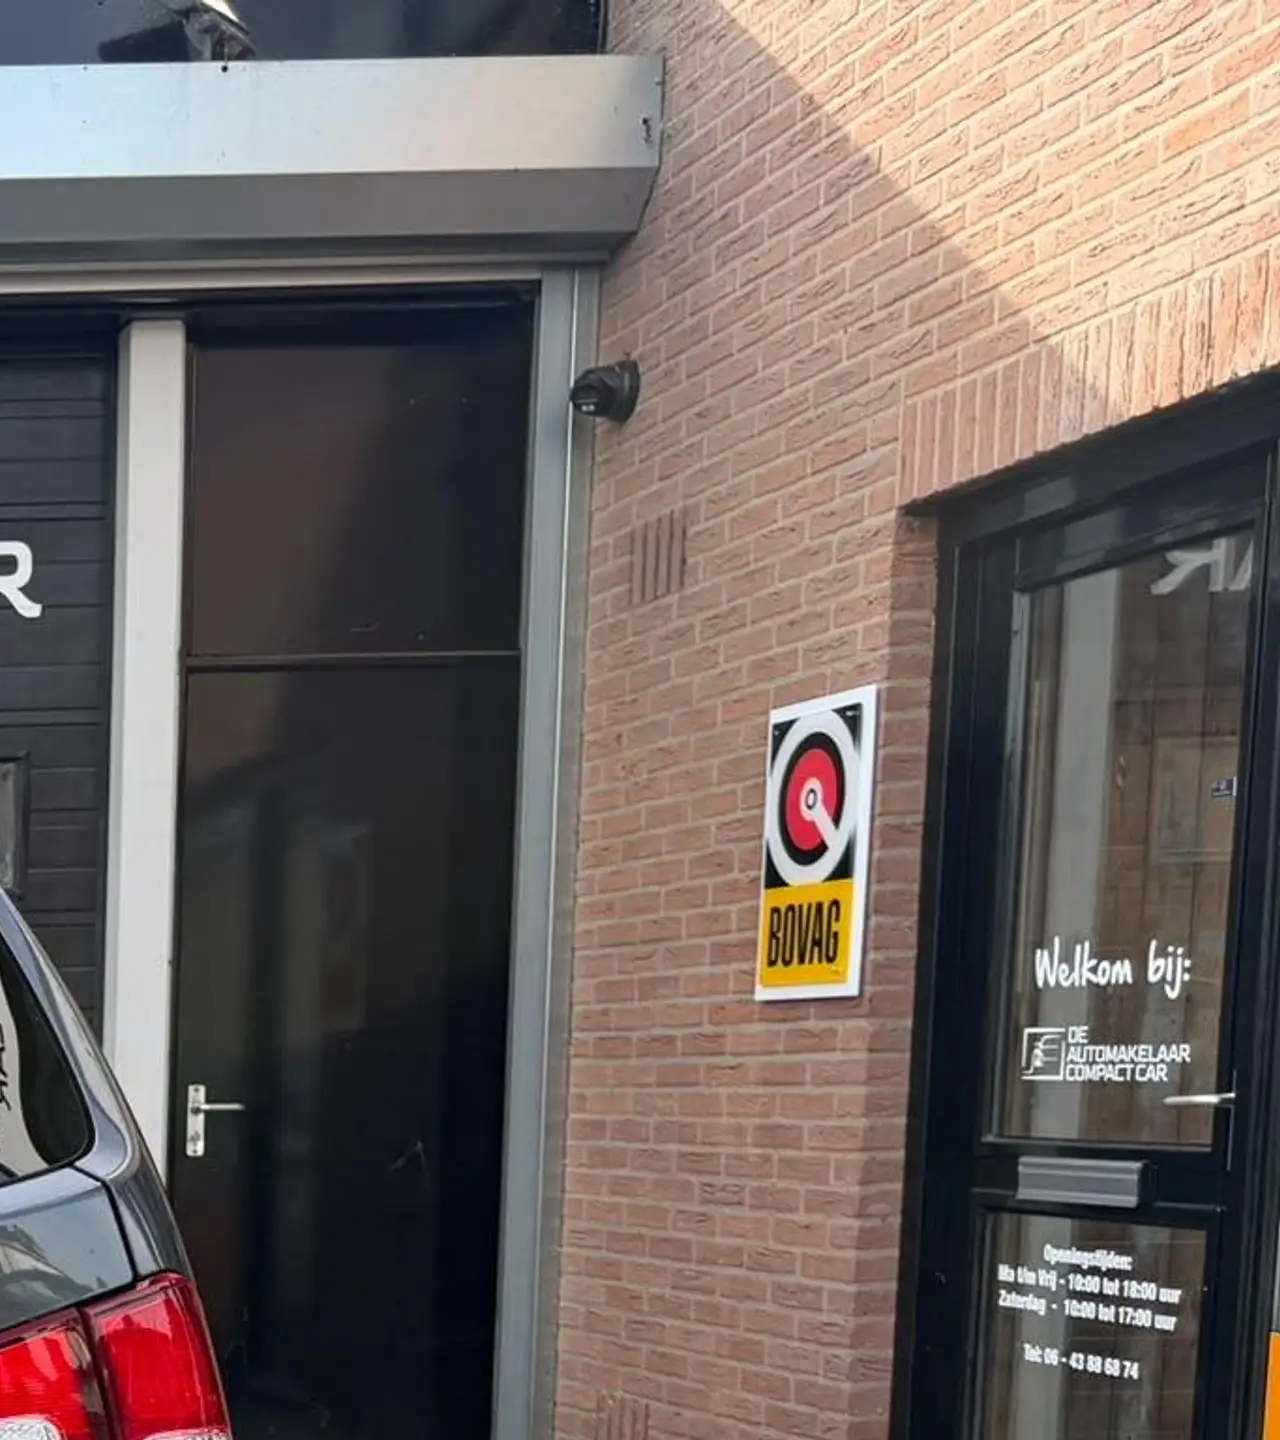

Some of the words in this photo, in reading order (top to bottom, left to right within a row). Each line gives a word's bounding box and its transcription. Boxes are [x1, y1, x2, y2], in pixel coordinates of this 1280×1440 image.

[767, 898, 842, 967] BOVAG
[1035, 935, 1133, 989] Welkom
[1147, 939, 1191, 1000] bij:
[1067, 1025, 1089, 1044] DE
[1066, 1043, 1191, 1064] AUTOMAKELAAR
[1065, 1063, 1135, 1082] COMPACT
[1135, 1064, 1168, 1082] CAR
[1102, 1276, 1120, 1297] tot
[1158, 1286, 1182, 1305] uur
[1098, 1302, 1115, 1323] tot
[1154, 1313, 1178, 1331] uur
